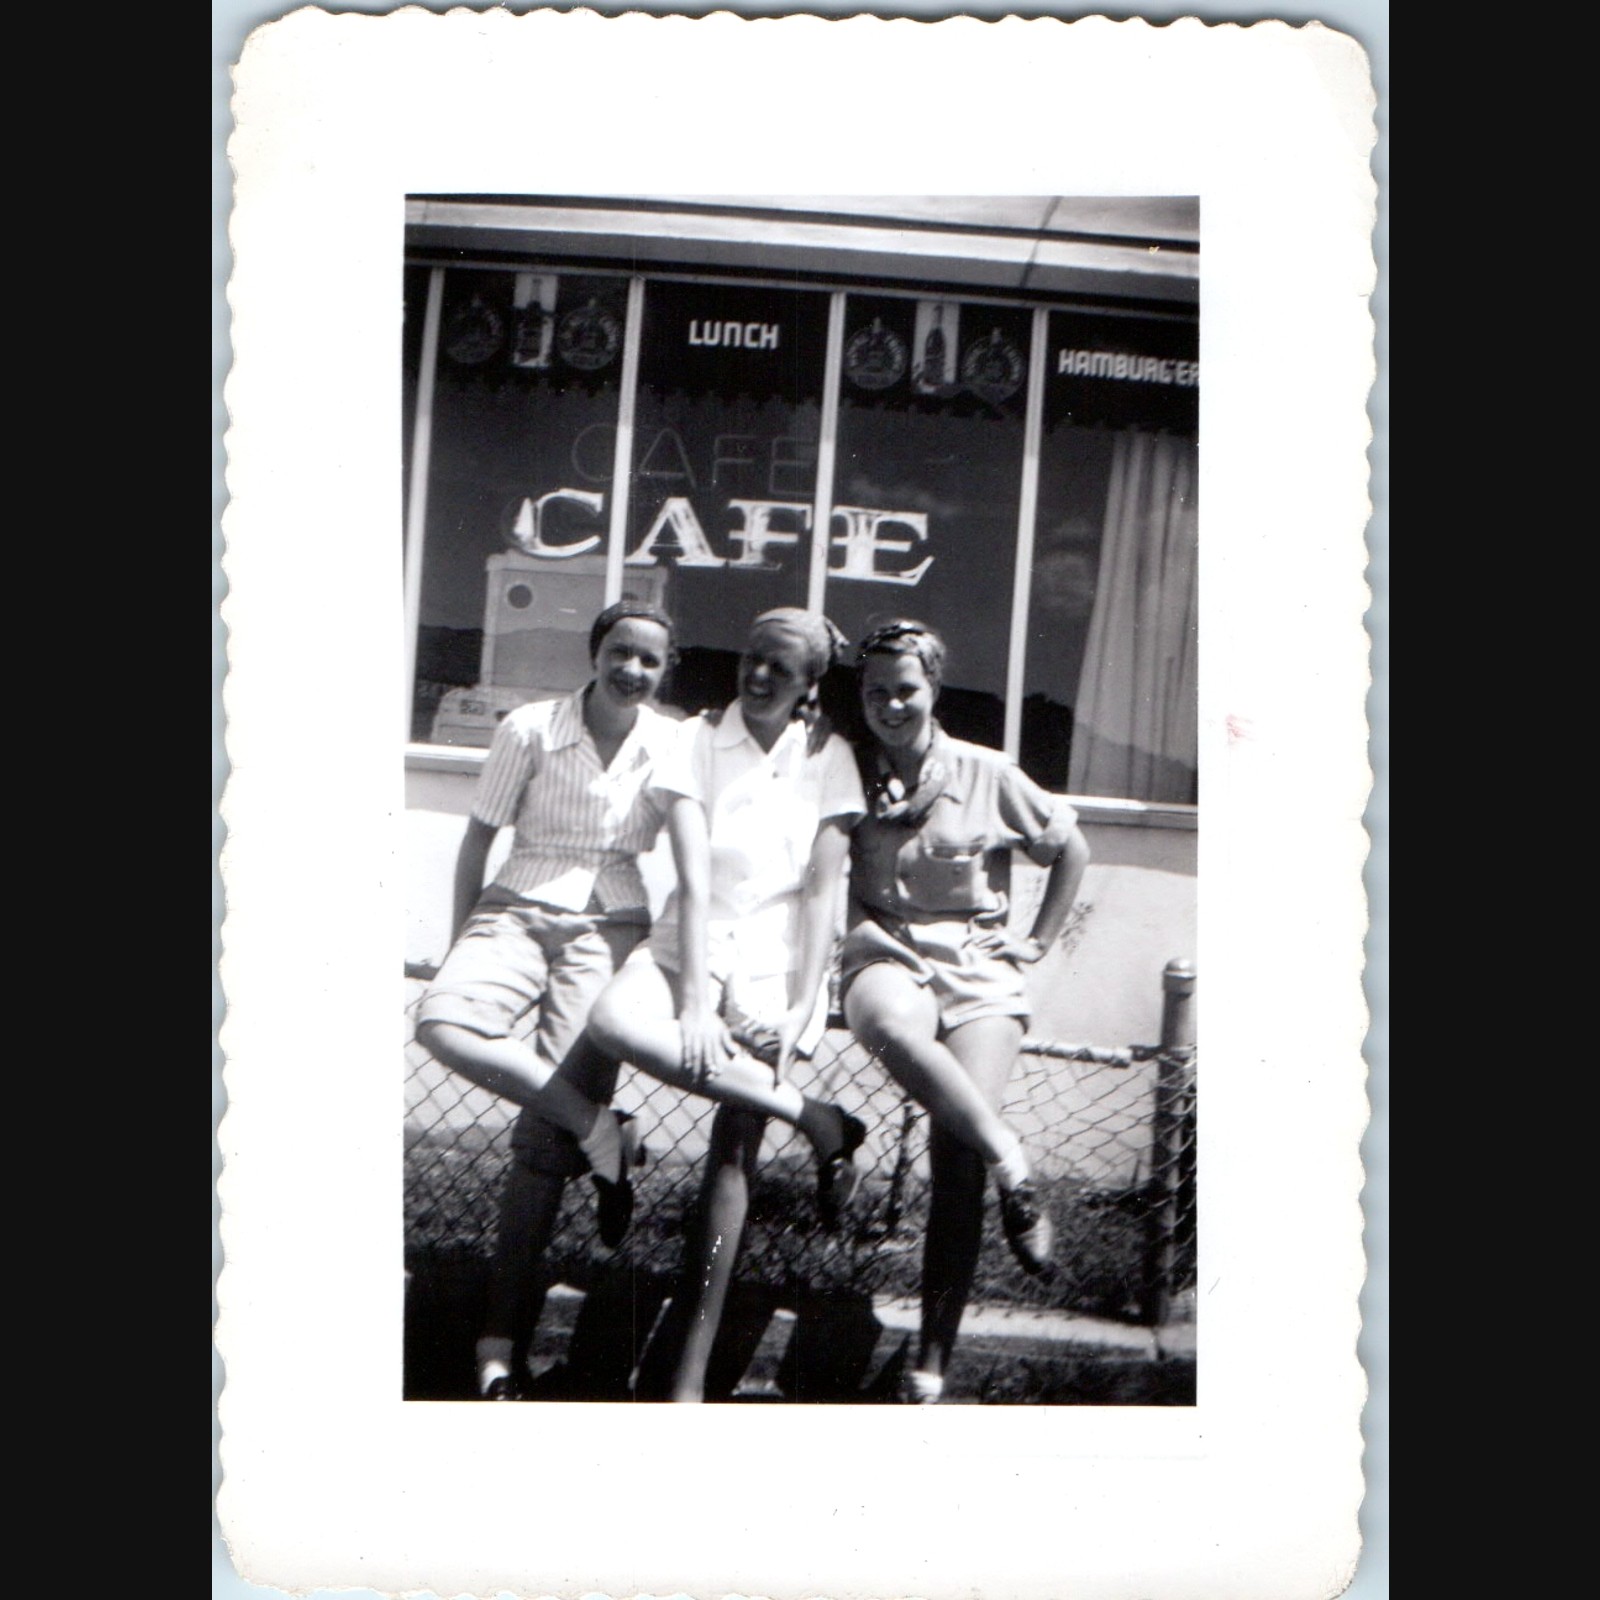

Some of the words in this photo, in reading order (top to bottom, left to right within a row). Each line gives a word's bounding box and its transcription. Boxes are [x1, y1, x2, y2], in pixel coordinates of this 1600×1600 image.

[688, 319, 780, 350] LUNCH
[571, 421, 817, 496] CAFE
[506, 487, 935, 586] CAFE
